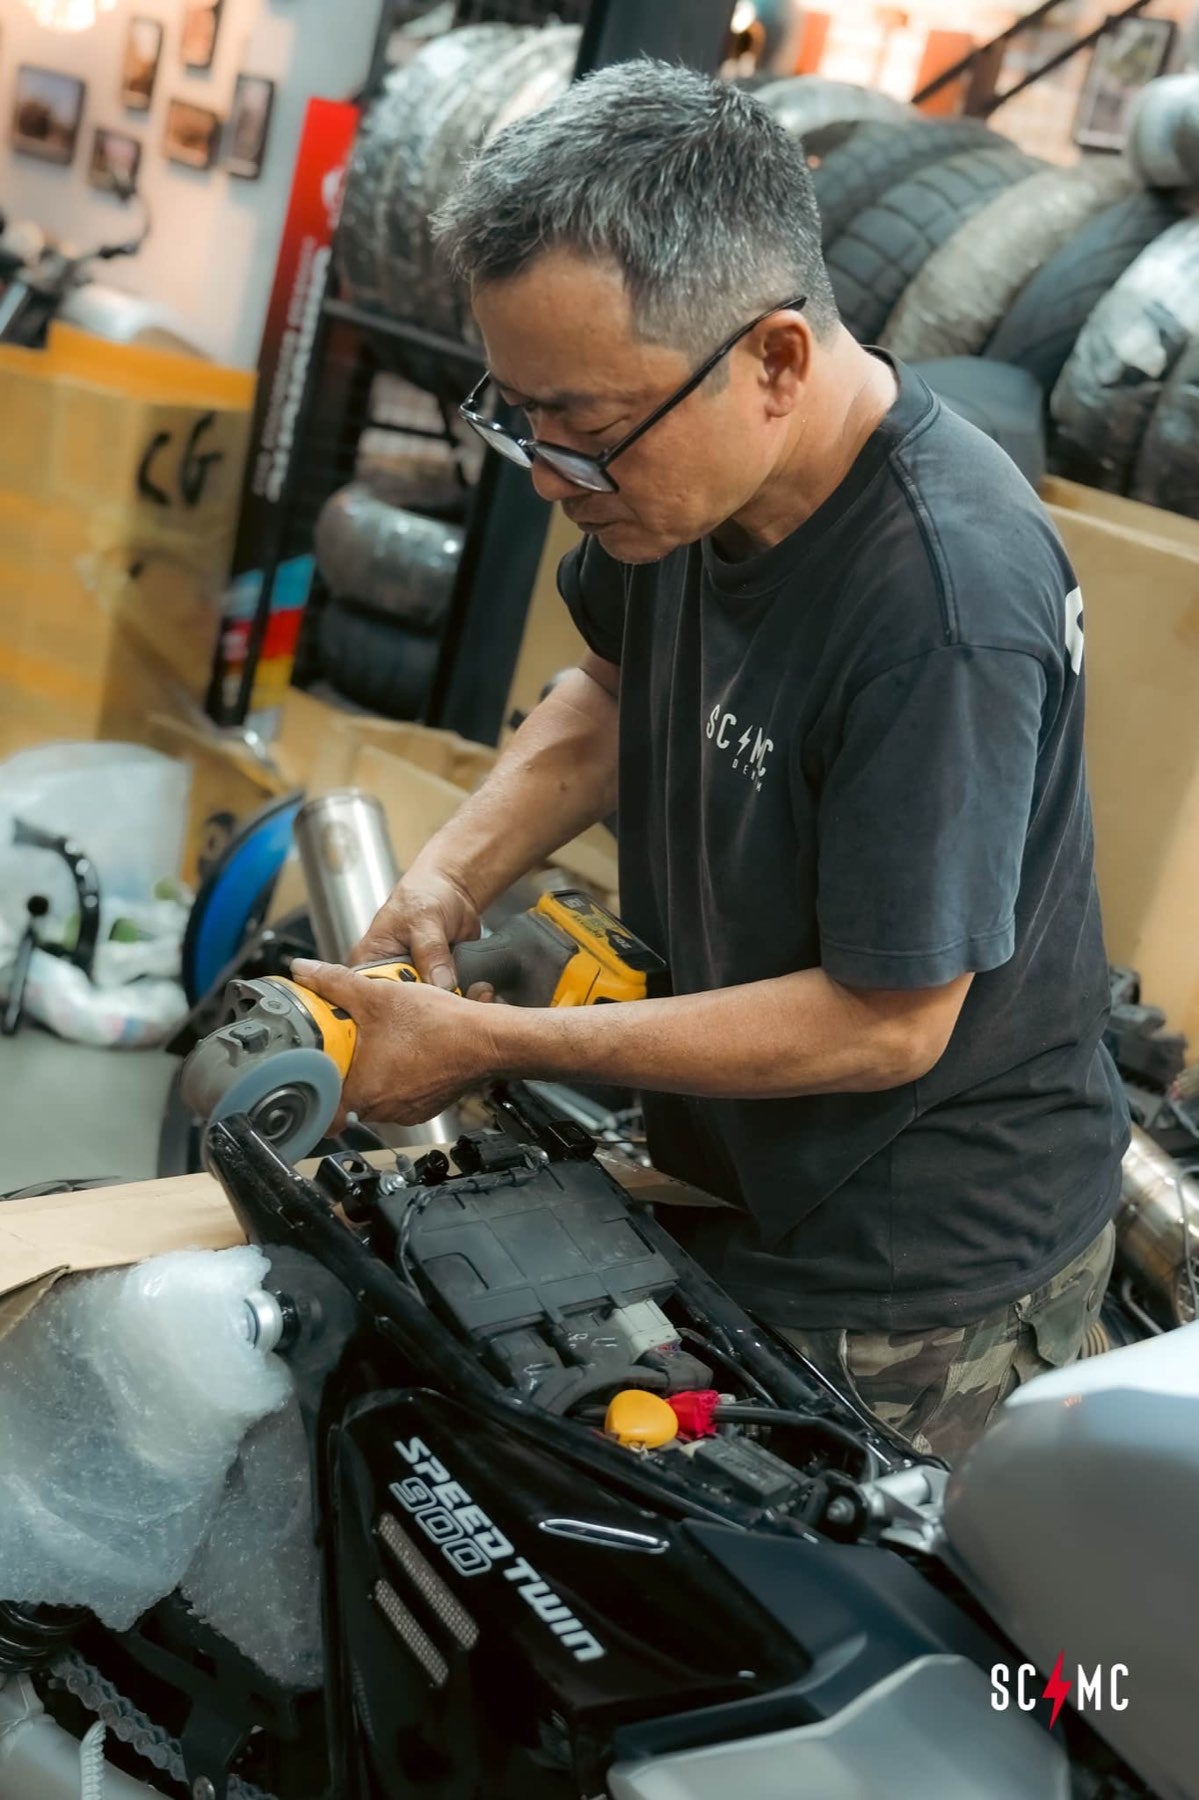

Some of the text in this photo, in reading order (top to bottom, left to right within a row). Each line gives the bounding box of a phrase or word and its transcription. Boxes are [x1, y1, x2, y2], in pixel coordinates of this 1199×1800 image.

[388, 1476, 493, 1577] 900
[394, 1436, 606, 1663] SPEED TWIN
